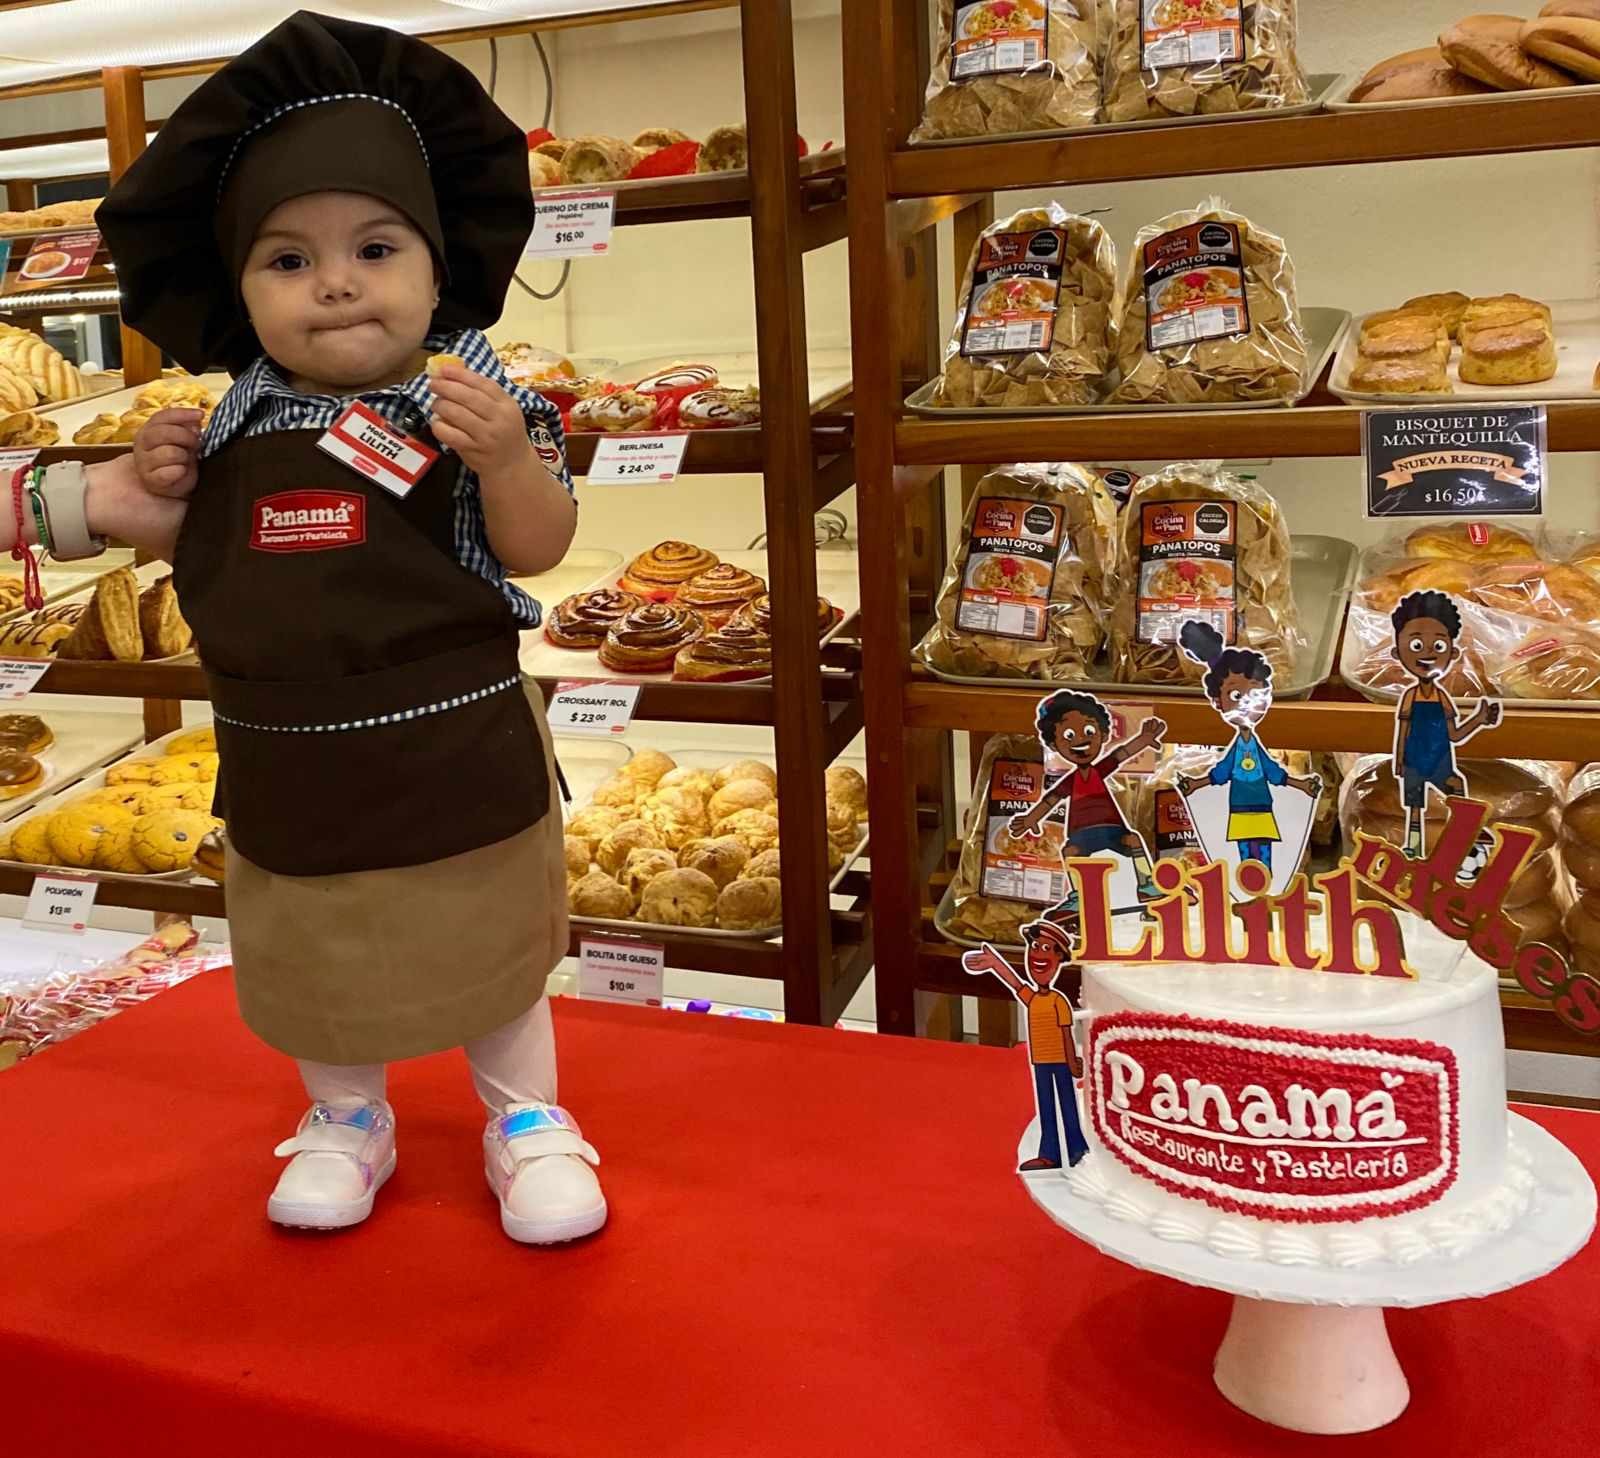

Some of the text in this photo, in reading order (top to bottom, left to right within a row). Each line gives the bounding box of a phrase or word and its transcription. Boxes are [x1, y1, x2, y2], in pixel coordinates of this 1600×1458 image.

[567, 203, 579, 212] DE
[580, 201, 609, 211] CREMA
[555, 231, 584, 243] $16.00
[1157, 253, 1227, 275] PANATOPOS
[366, 423, 386, 441] Hola
[1395, 415, 1509, 432] BISQUET DE
[359, 432, 399, 460] LILITH
[618, 442, 664, 451] BERLINESA
[1382, 430, 1523, 447] MANTEQUILLA
[1397, 454, 1508, 472] NUEVA RECETA
[261, 501, 351, 528] Panamá
[980, 537, 1045, 553] PANATOPOS
[1152, 540, 1222, 554] PANATOPOS
[557, 696, 627, 707] CROISSANT ROL
[45, 886, 83, 896] POLVORÓN
[1069, 856, 1420, 982] Lilith
[586, 949, 657, 965] BOLITA DE QUESO
[1105, 1050, 1407, 1142] Panamá
[1120, 1111, 1409, 1185] Restaurante y Pastelería
